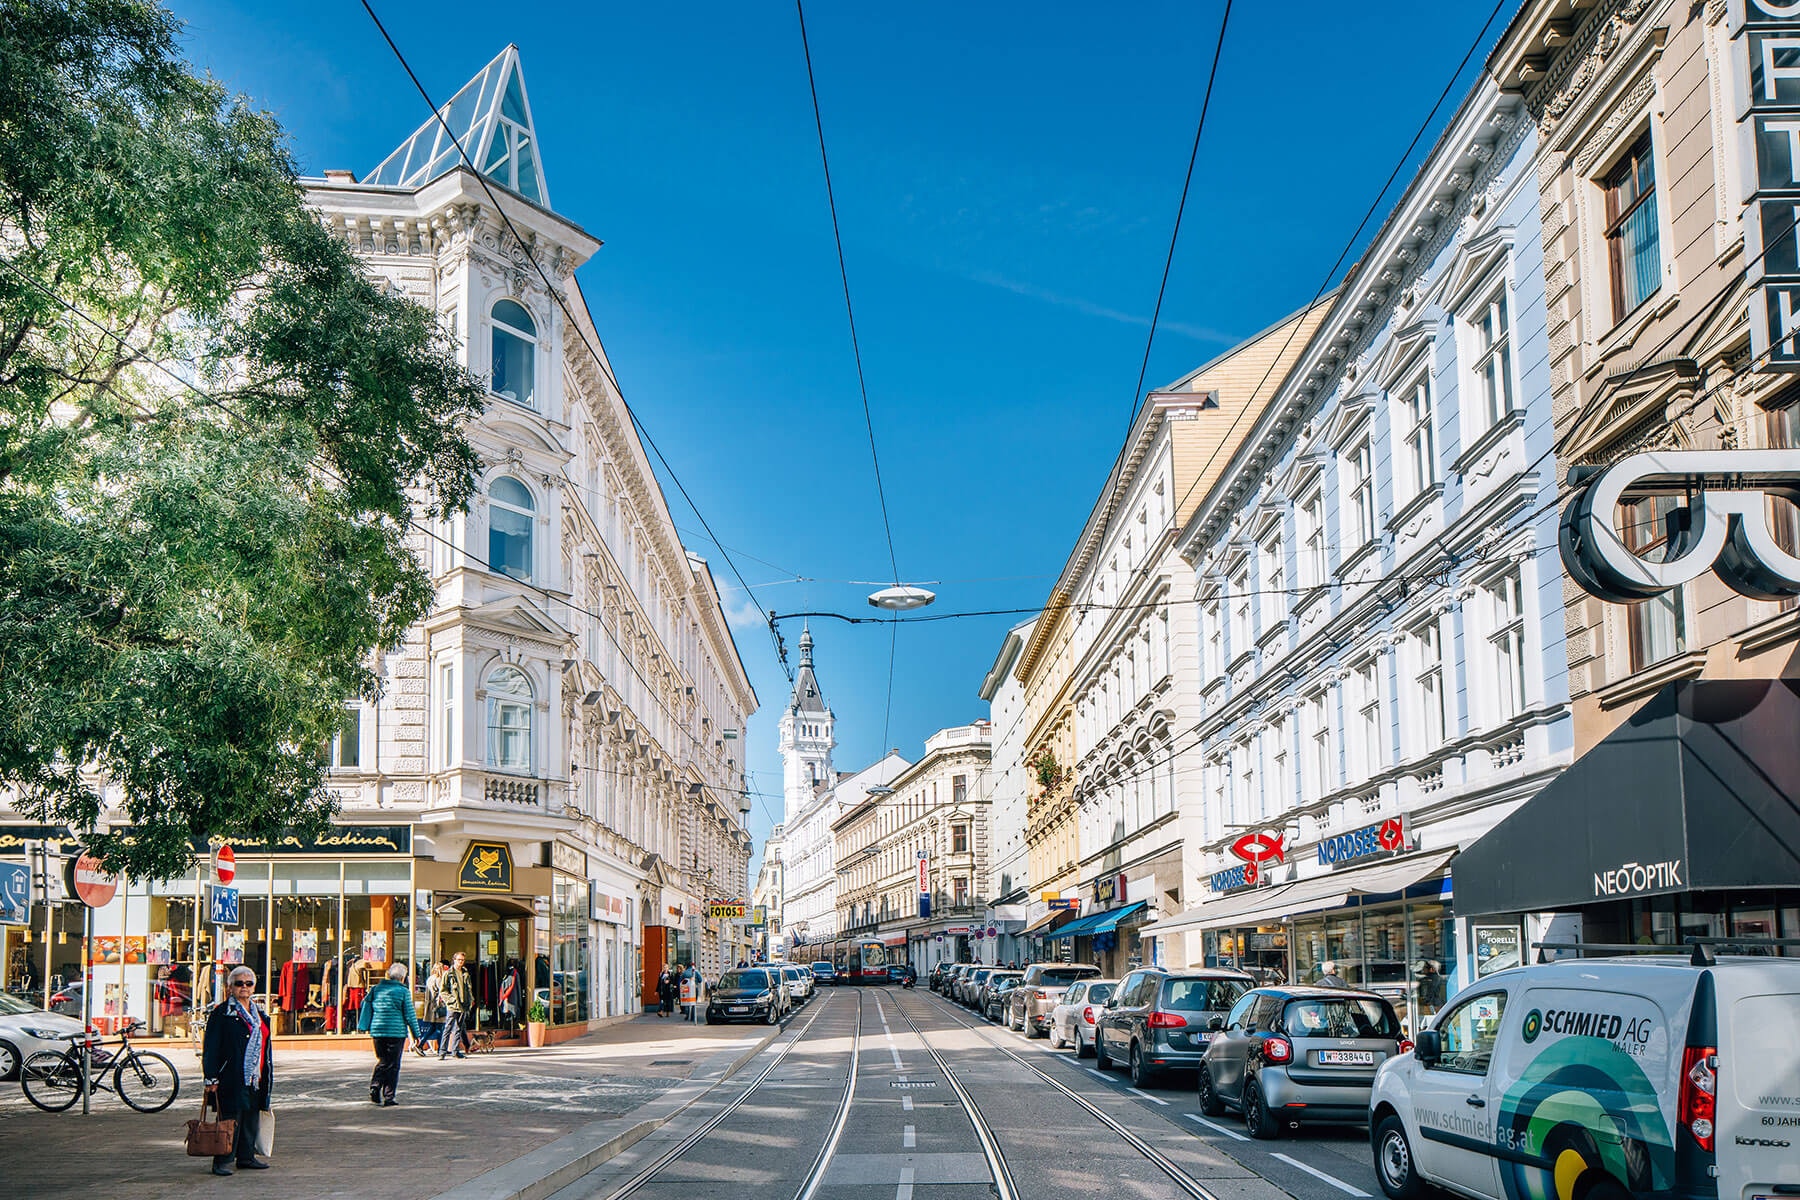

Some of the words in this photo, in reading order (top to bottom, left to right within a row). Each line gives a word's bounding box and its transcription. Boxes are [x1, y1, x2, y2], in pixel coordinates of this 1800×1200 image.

[314, 831, 398, 850] latina
[1318, 827, 1378, 865] NORDSEE
[1210, 865, 1245, 893] NORDSEE
[710, 907, 737, 917] FOTOS
[1542, 1009, 1622, 1039] SCHMIED
[1622, 1017, 1652, 1043] AG
[1611, 1041, 1646, 1056] MALER
[1413, 1106, 1536, 1152] www.schmied-ag.at
[1761, 1116, 1775, 1126] 60
